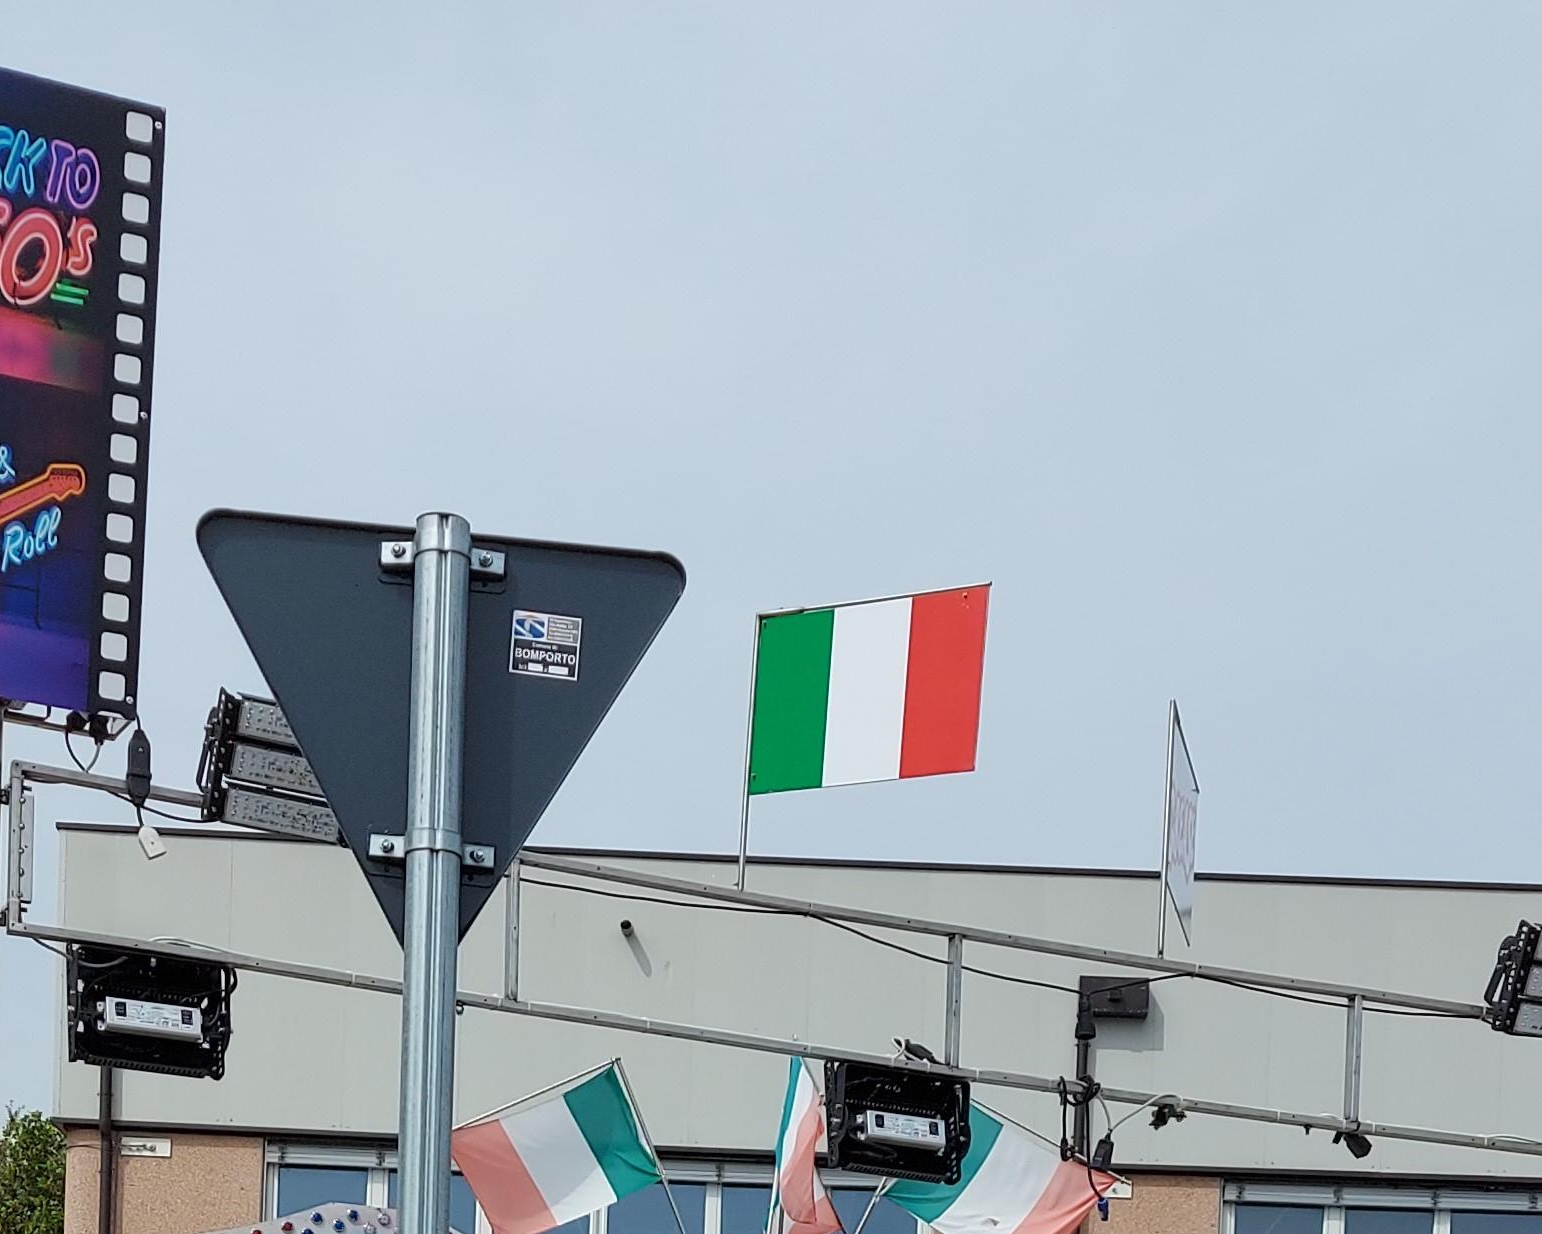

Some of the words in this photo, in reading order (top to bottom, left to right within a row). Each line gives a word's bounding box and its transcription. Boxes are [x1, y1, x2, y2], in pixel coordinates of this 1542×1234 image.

[47, 139, 100, 209] TO
[1, 506, 61, 572] Roll
[515, 647, 576, 665] BOMPORTO
